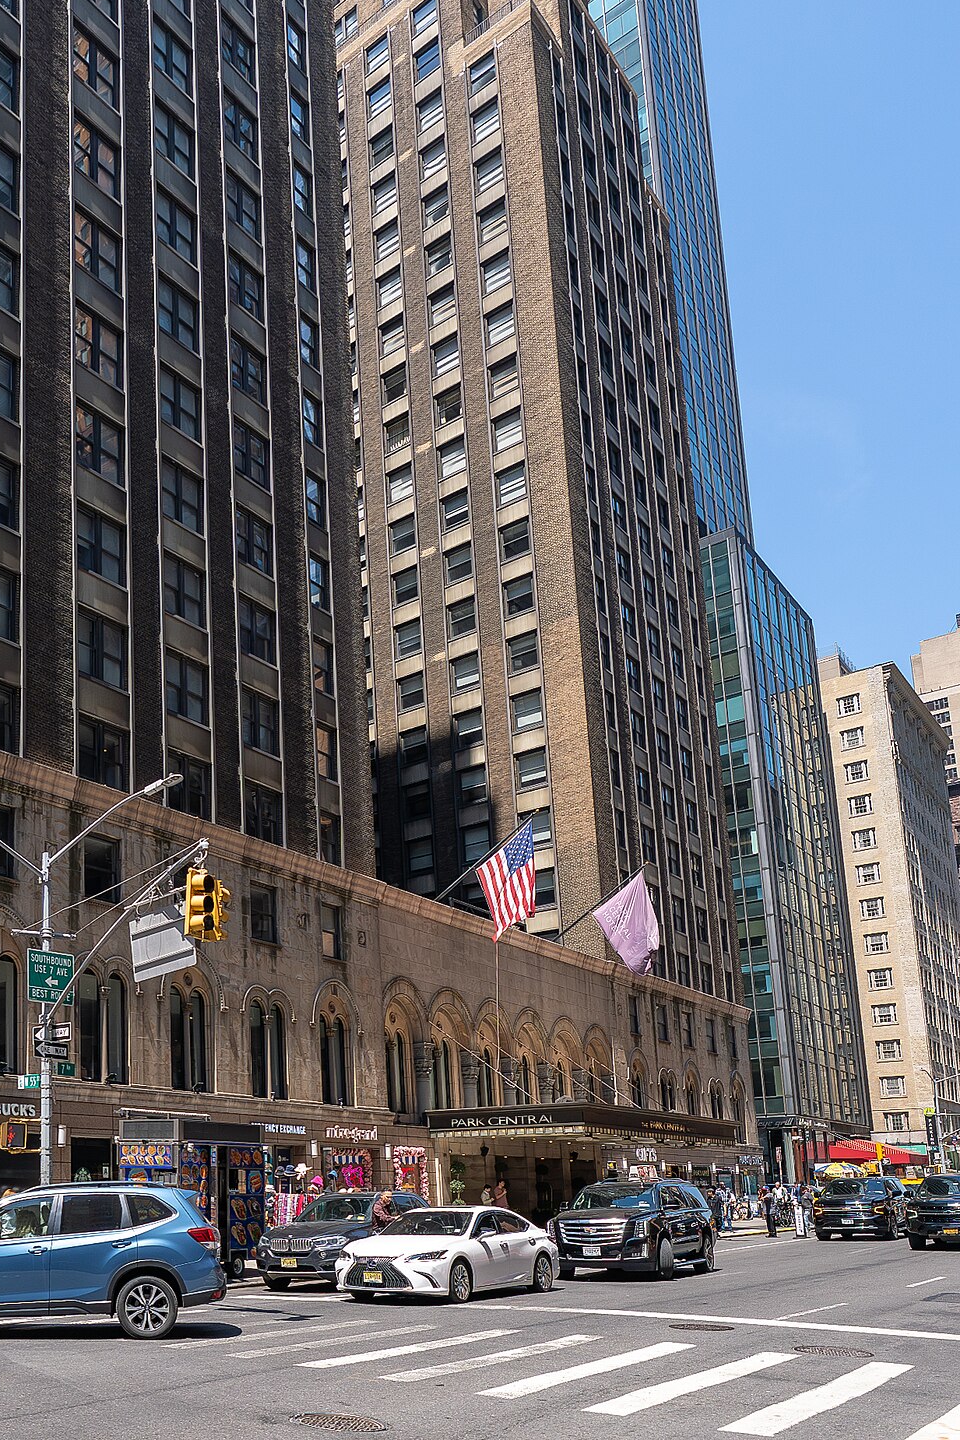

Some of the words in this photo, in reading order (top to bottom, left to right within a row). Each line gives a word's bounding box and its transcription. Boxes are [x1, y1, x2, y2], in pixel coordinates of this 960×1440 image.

[609, 906, 632, 939] CENRAL
[31, 953, 72, 967] SOUTHBOUND
[34, 964, 47, 973] USE
[50, 965, 54, 975] 7
[56, 967, 68, 977] AVE
[32, 988, 48, 998] BEST
[51, 991, 70, 1001] ROE
[62, 1065, 66, 1074] 7
[29, 1076, 37, 1087] 55
[451, 1117, 485, 1128] PARK
[650, 1120, 663, 1129] PARK
[279, 1124, 307, 1135] EXCHANGE
